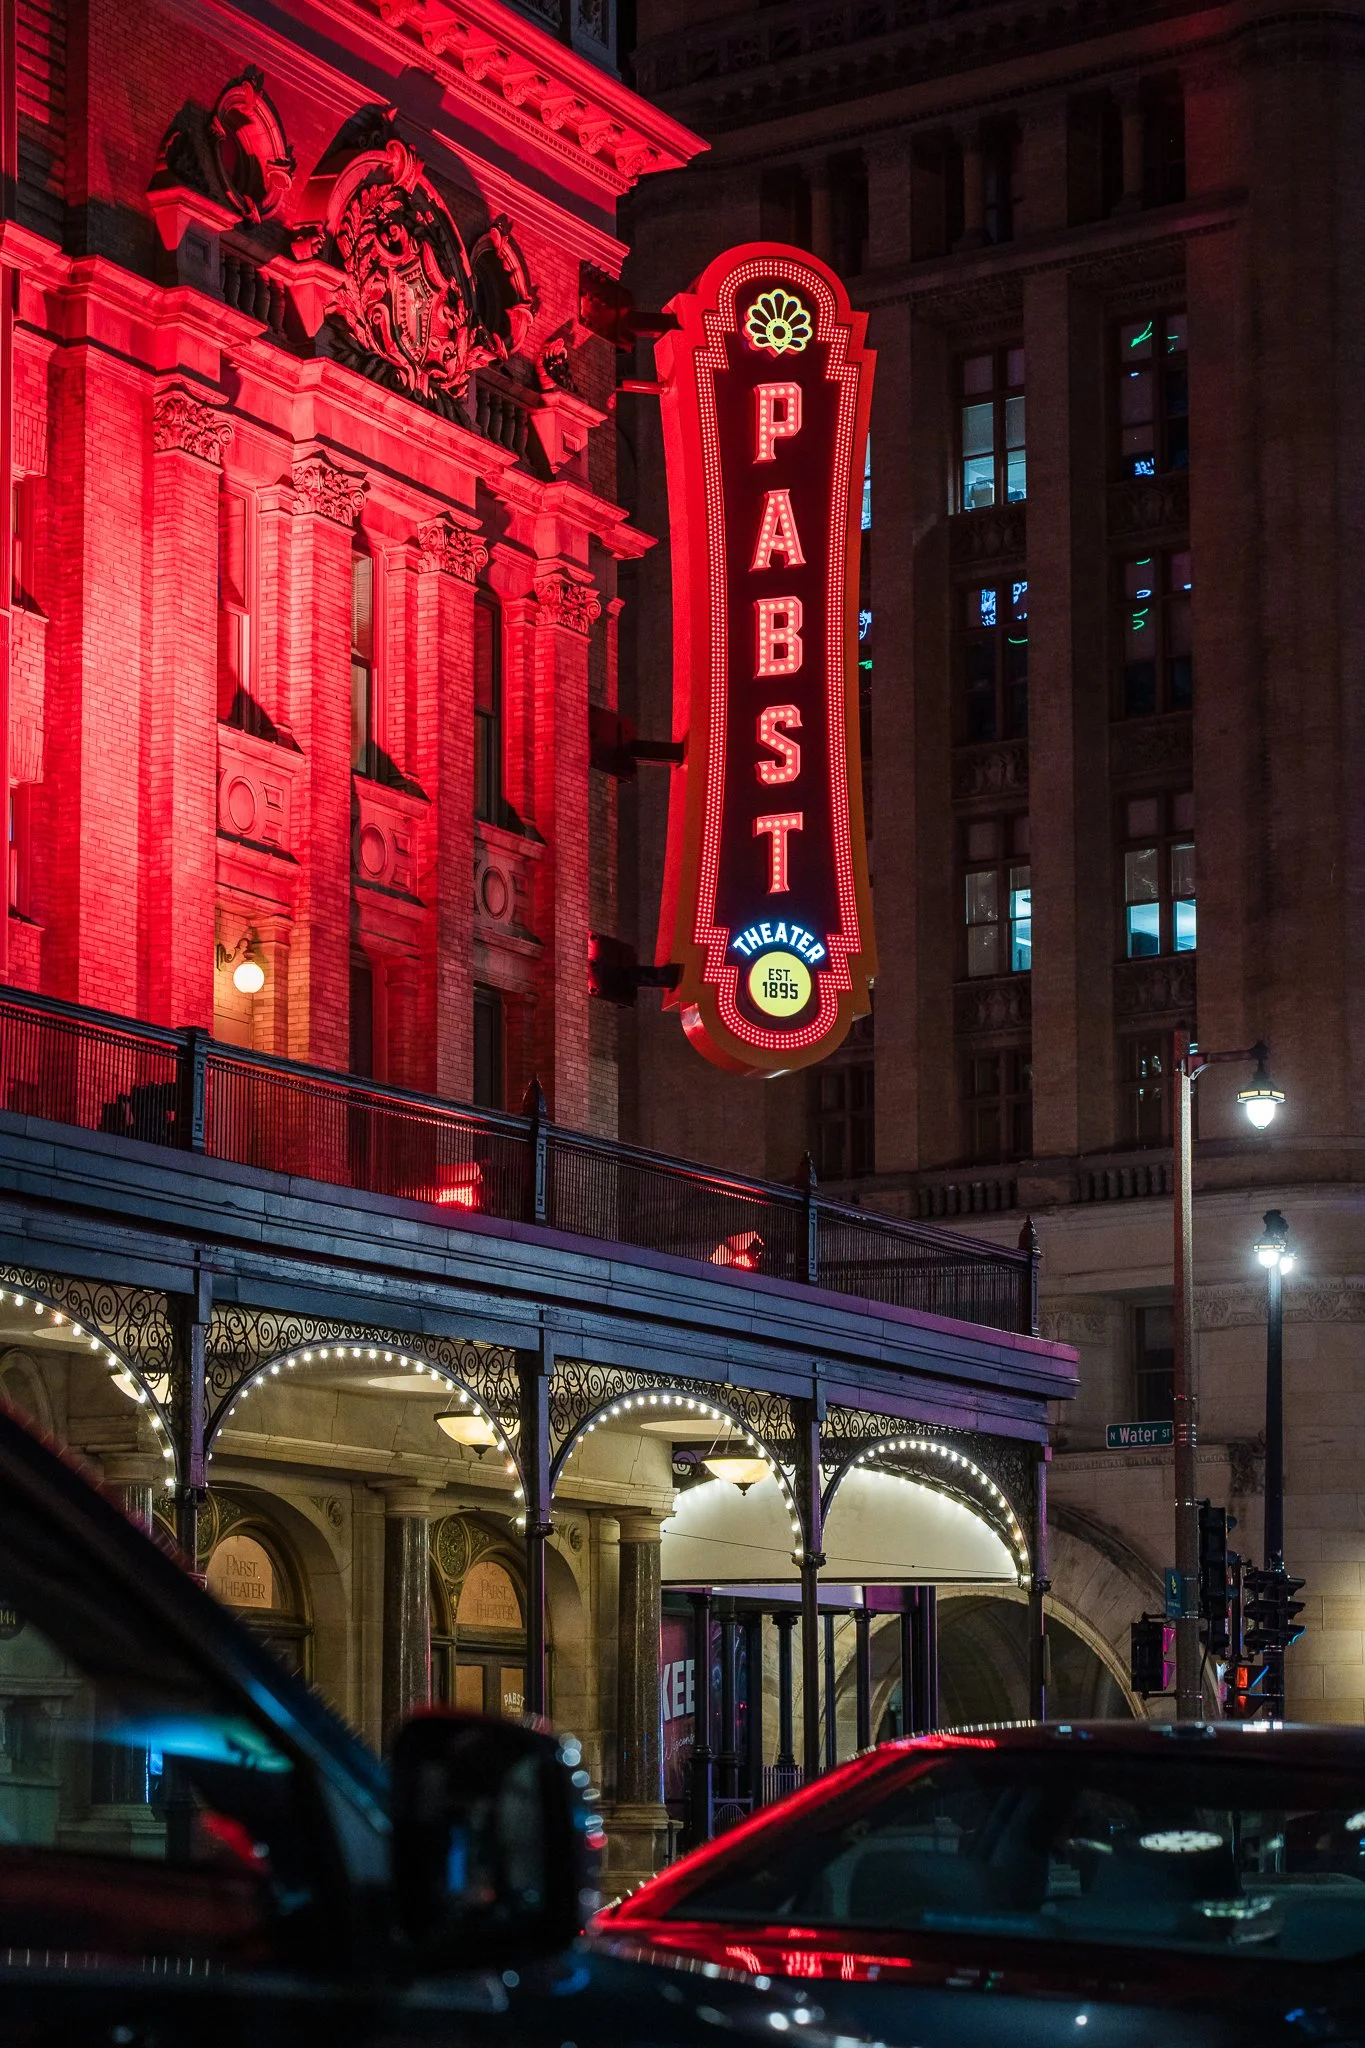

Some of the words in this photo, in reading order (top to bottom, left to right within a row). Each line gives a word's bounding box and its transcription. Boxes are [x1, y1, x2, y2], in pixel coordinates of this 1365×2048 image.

[748, 381, 806, 894] PABST
[732, 922, 826, 964] THEATER
[768, 968, 793, 982] EST.
[762, 982, 799, 1000] 1895
[1110, 1432, 1116, 1441] N
[1119, 1427, 1158, 1444] Water
[503, 1692, 526, 1707] PABST
